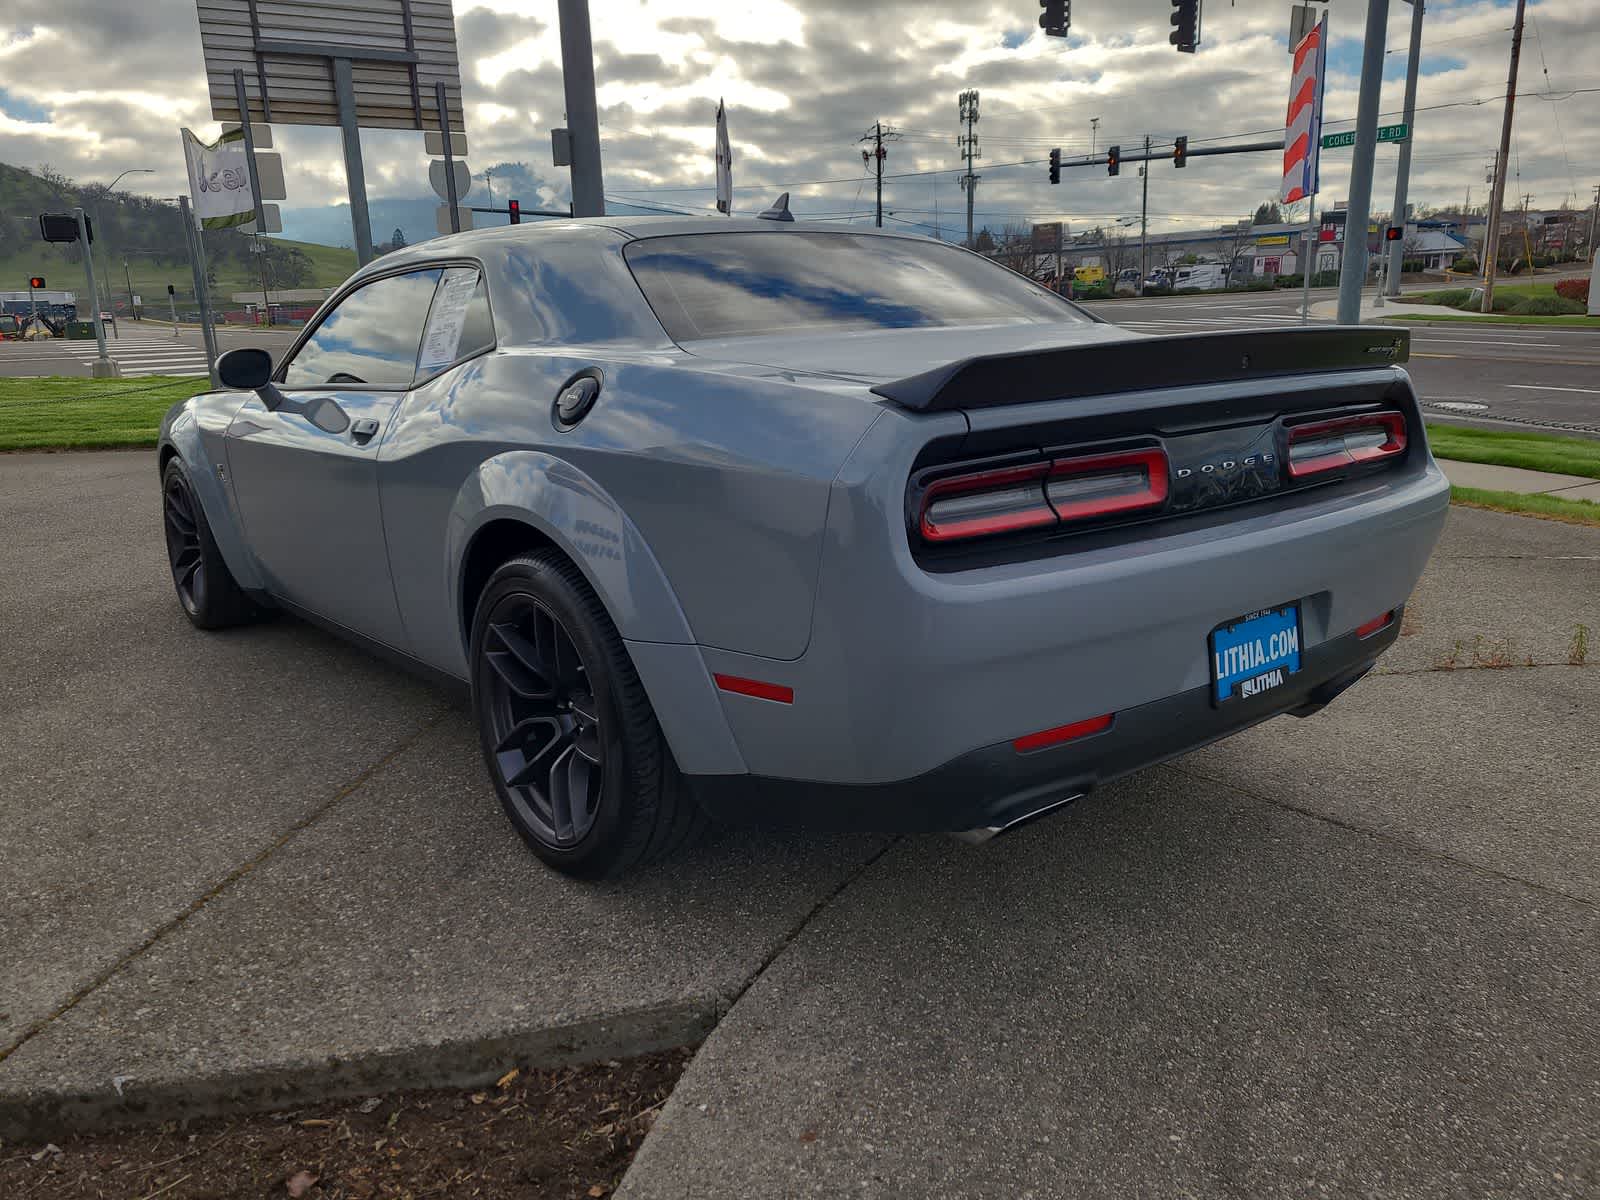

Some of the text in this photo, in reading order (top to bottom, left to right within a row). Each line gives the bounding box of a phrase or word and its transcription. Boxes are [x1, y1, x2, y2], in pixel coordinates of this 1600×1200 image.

[1389, 127, 1401, 137] RD
[1177, 454, 1274, 480] DODGE
[1215, 626, 1299, 680] LITHIA.COM
[1251, 669, 1284, 695] LITHIA
